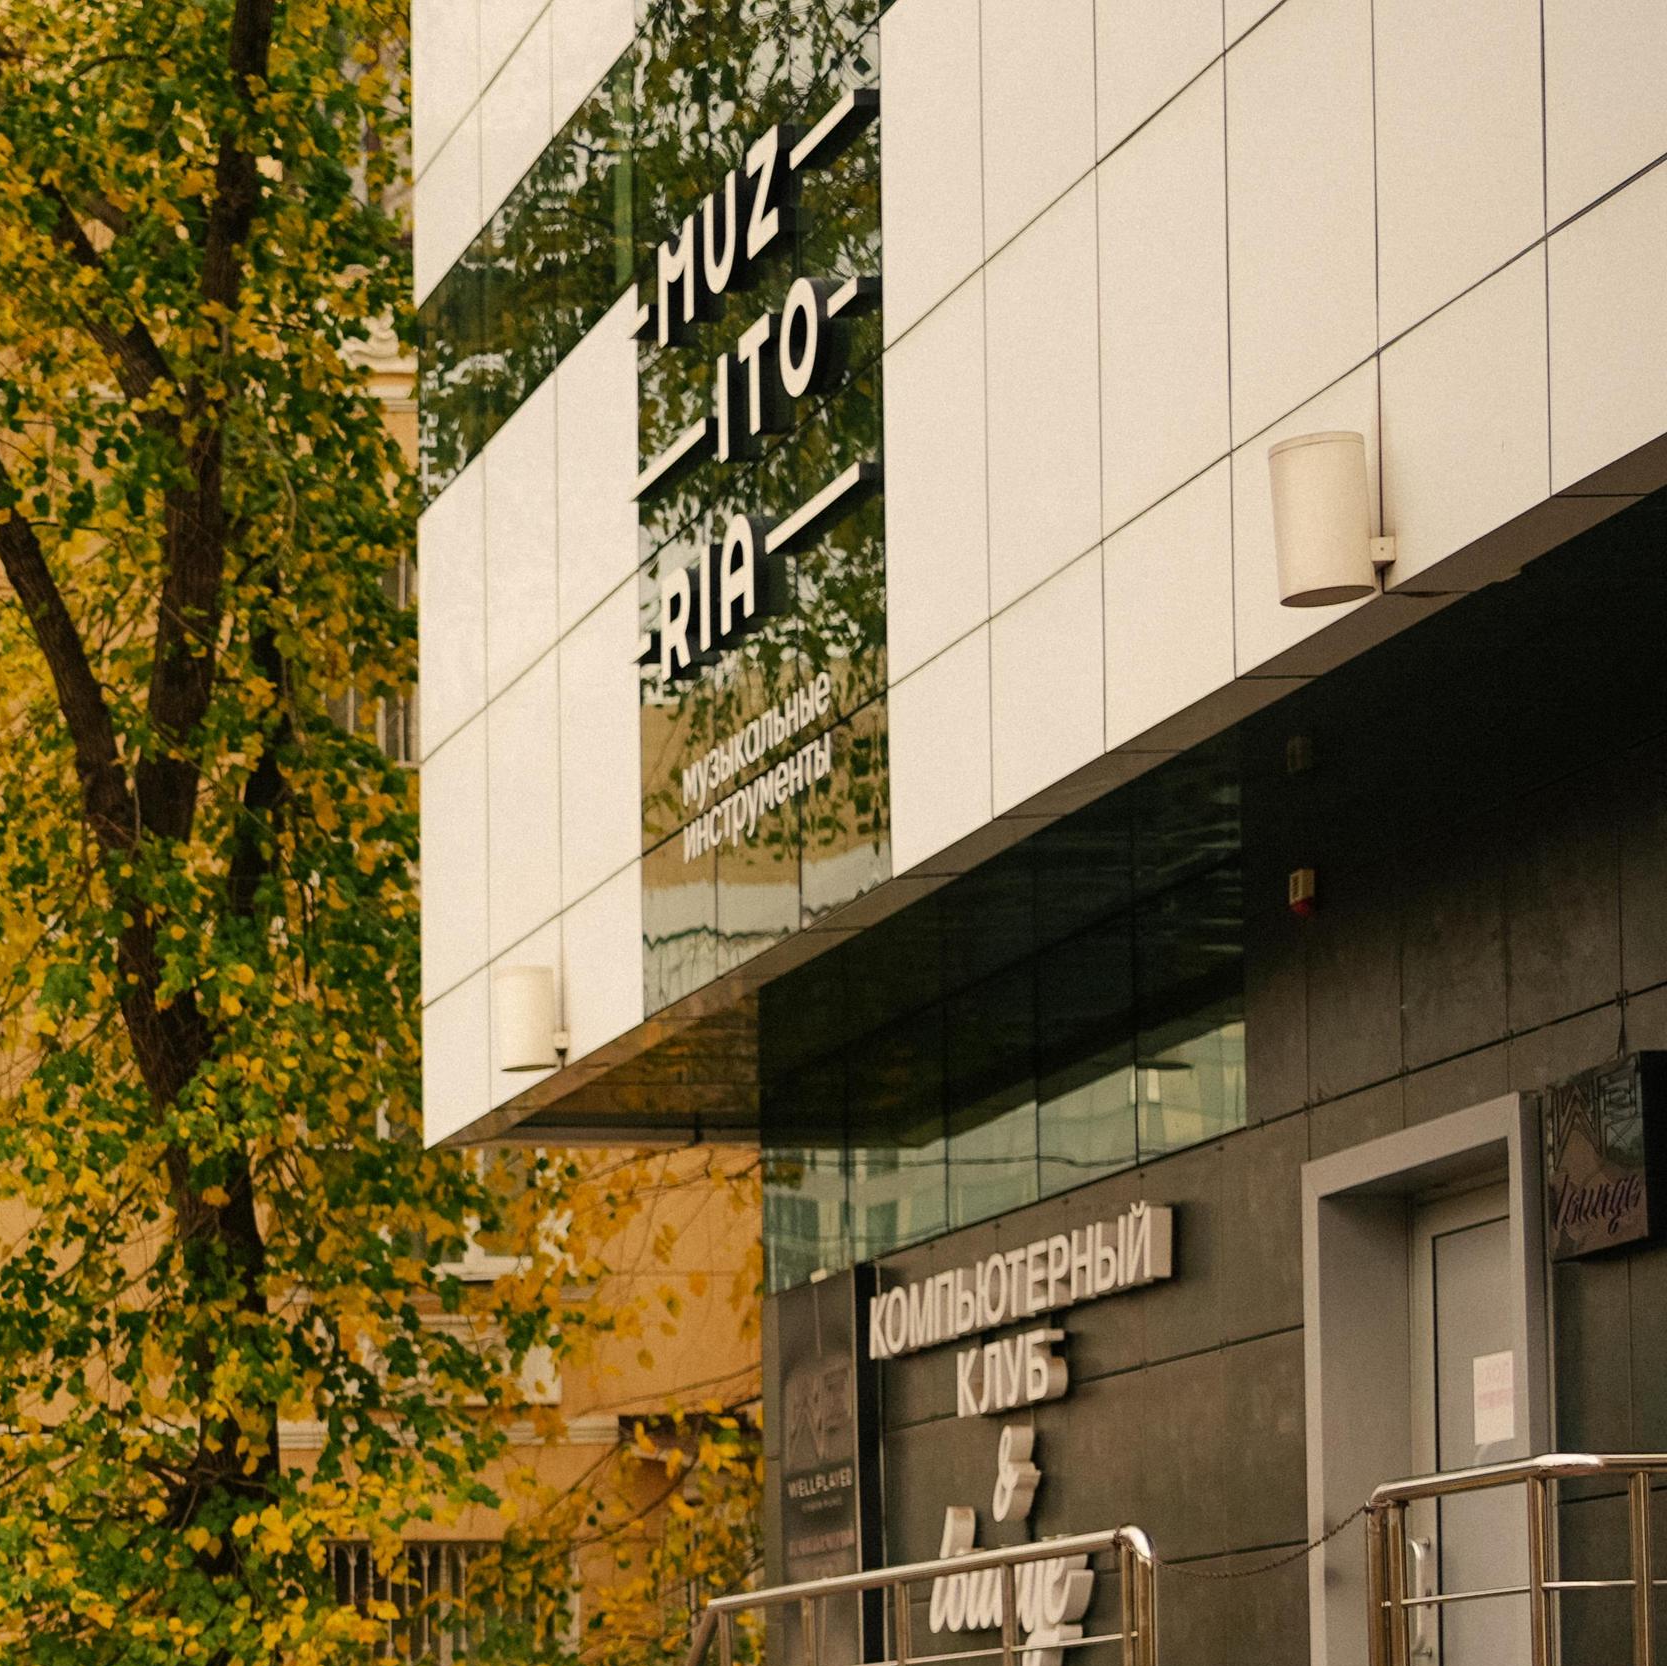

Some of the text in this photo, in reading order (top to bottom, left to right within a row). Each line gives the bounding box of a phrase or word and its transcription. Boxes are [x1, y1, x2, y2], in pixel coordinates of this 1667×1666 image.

[682, 671, 831, 812] музыкальные
[683, 732, 831, 864] инструменты
[869, 1201, 1155, 1360] КОМПЬЮТЕРНЫЙ
[957, 1328, 1057, 1418] КЛУБ
